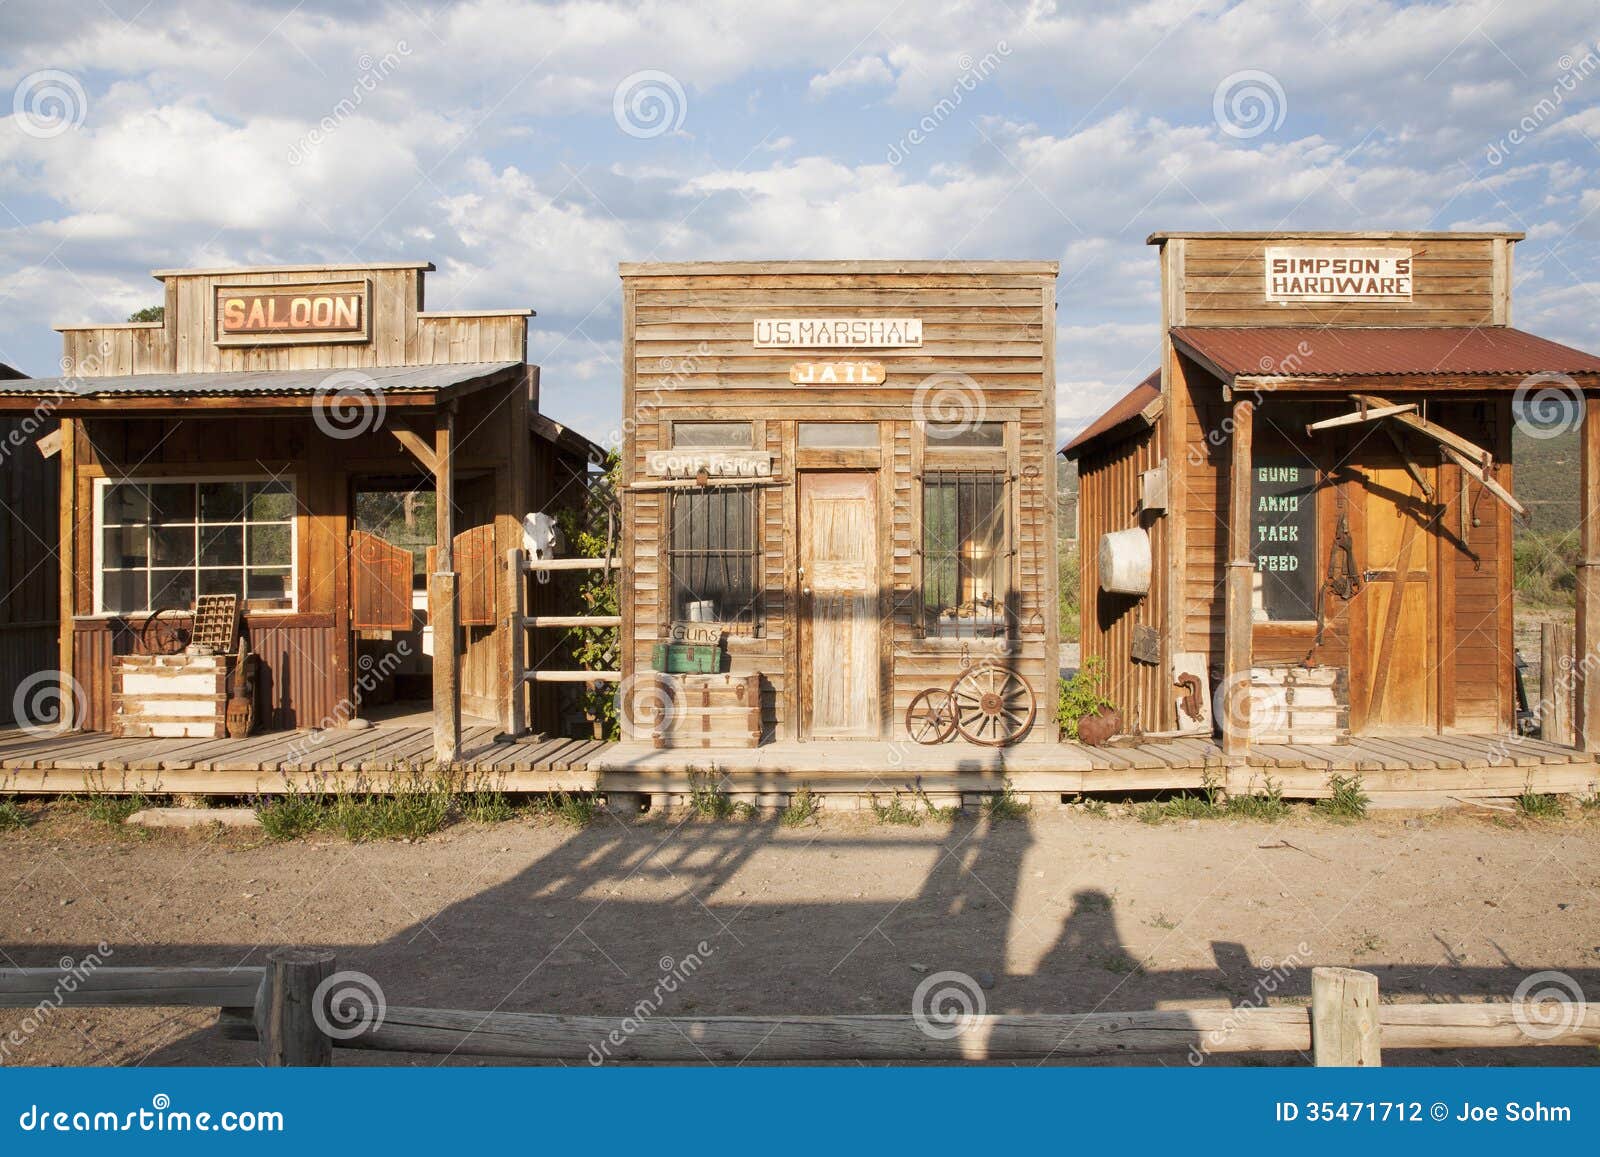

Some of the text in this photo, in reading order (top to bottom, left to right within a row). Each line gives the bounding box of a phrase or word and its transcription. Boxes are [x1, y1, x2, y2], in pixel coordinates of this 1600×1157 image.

[1272, 277, 1410, 293] HARDWARE
[224, 296, 359, 329] SALOON
[798, 364, 877, 382] JAIL
[1258, 467, 1298, 481] GUNS
[1258, 496, 1298, 511] AMMO
[1258, 526, 1298, 541] TACK
[1258, 556, 1298, 571] FEED
[672, 625, 718, 641] Guns
